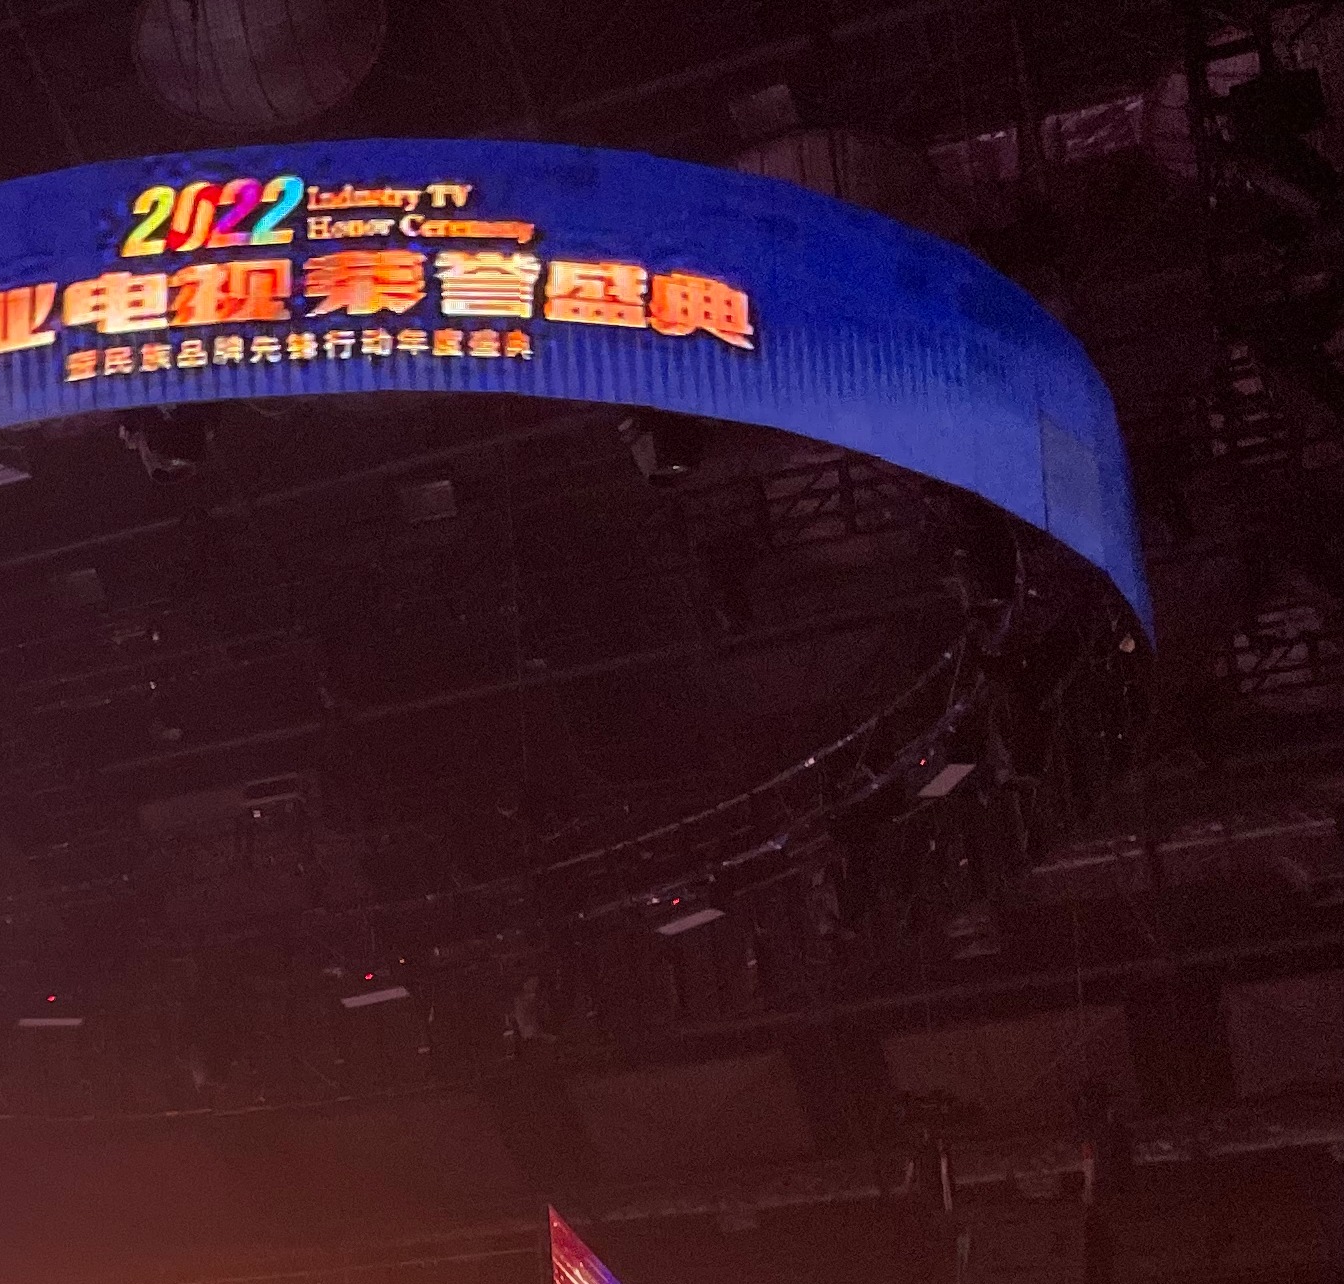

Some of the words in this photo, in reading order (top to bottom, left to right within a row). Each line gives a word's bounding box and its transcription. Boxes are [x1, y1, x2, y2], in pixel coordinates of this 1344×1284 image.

[425, 183, 472, 207] TV
[120, 174, 305, 257] 2022
[307, 215, 395, 239] Honor
